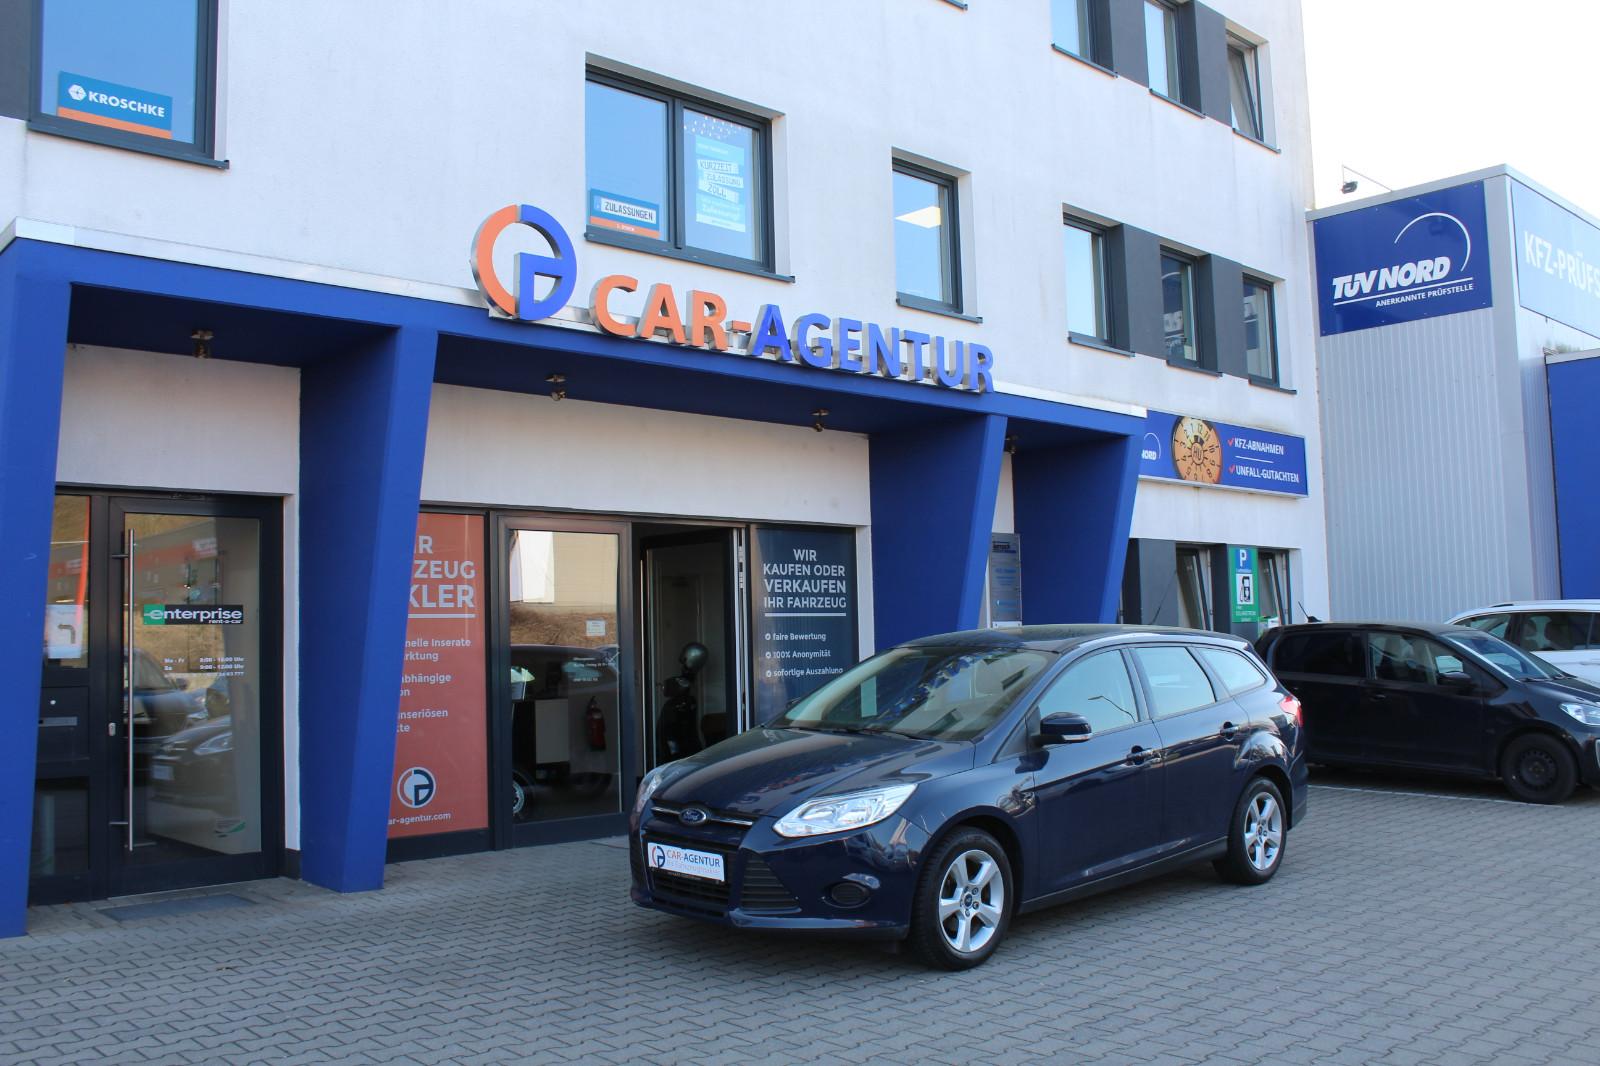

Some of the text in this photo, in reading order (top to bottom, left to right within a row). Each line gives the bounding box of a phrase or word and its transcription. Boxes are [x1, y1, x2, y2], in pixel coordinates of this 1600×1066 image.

[88, 91, 165, 118] KROSCHKE
[604, 201, 653, 221] ZULASSUNGEN
[1332, 256, 1451, 300] TÜV NORD
[1376, 282, 1474, 308] ANERKANNTE PRÜFSTELLE
[591, 274, 994, 394] CAR-AGENTUR
[1234, 438, 1284, 456] KFZ-ABNAHMEN
[1235, 466, 1300, 483] UNFALL-GUTACHTEN
[793, 548, 817, 561] WIR
[1240, 549, 1247, 567] P
[763, 564, 845, 576] KAUFEN ODER
[764, 579, 847, 593] VERKAUFEN
[764, 596, 847, 608] IHR FAHRZEUG
[148, 608, 242, 622] enterprise
[432, 638, 472, 647] Inserate
[790, 633, 827, 642] Bewertung
[792, 649, 831, 660] Anonymität
[774, 666, 844, 678] sofortige Auszahlung
[684, 810, 699, 821] Ford
[666, 850, 720, 868] CAR-AGENTUR
